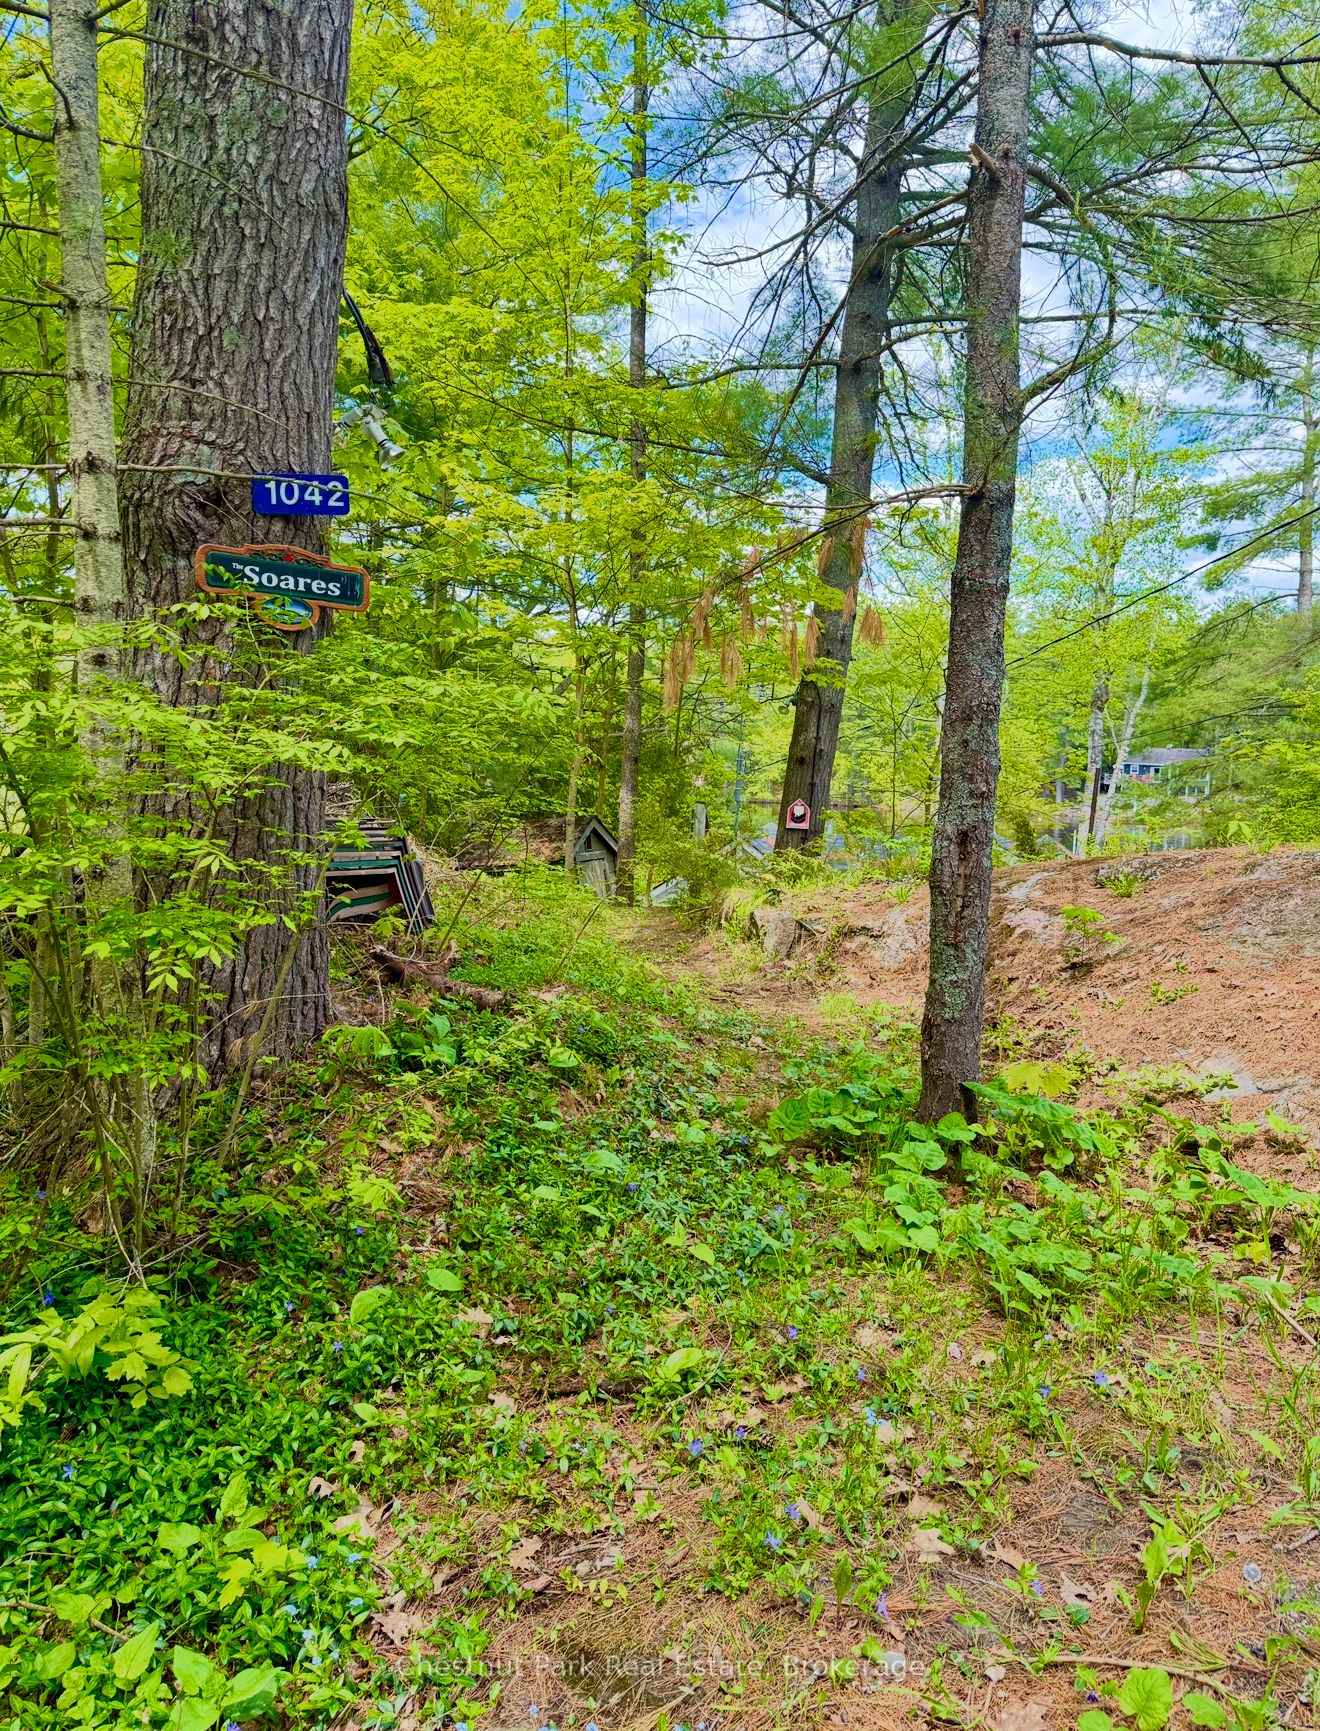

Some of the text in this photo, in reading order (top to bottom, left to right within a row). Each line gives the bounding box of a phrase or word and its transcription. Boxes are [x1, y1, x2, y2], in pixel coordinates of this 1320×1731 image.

[264, 480, 345, 507] 1042
[231, 562, 342, 597] The Soares
